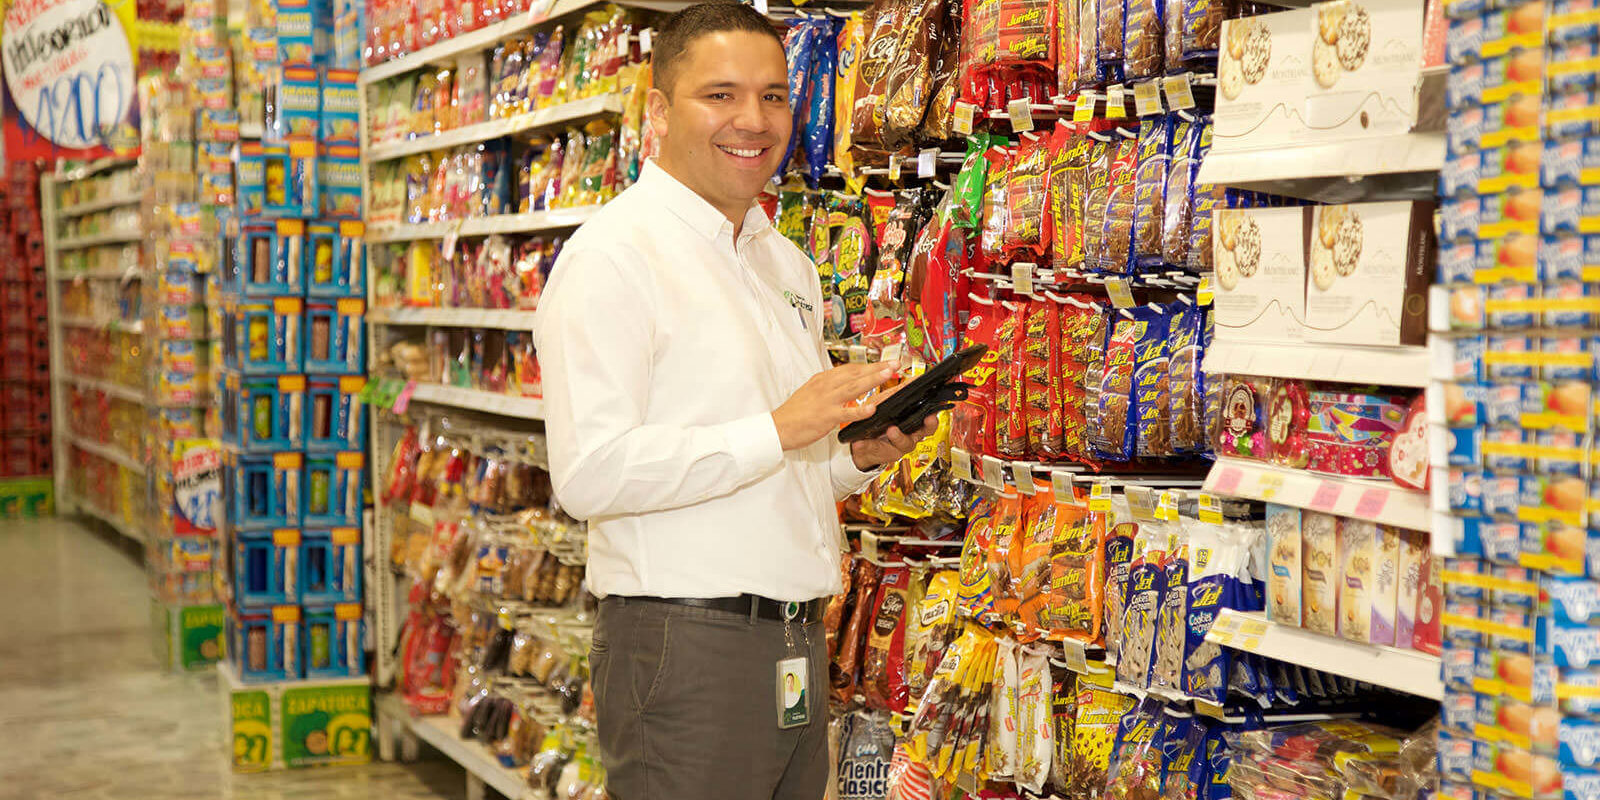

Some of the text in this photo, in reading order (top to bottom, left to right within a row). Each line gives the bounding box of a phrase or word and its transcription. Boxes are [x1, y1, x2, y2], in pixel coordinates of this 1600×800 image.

[1007, 7, 1041, 26] Jumbo
[929, 23, 938, 40] Trio
[1052, 140, 1090, 166] Jumbo
[1091, 171, 1108, 189] Jet
[1113, 169, 1136, 185] Jet
[1170, 328, 1194, 353] Jet
[1109, 349, 1131, 366] Jet
[1137, 340, 1168, 363] Jet
[1111, 546, 1129, 563] Jet
[1135, 573, 1155, 591] Jet
[1192, 585, 1223, 608] Jet
[1189, 612, 1212, 626] Cookies
[1123, 720, 1162, 743] Jet
[1168, 747, 1195, 771] Jet
